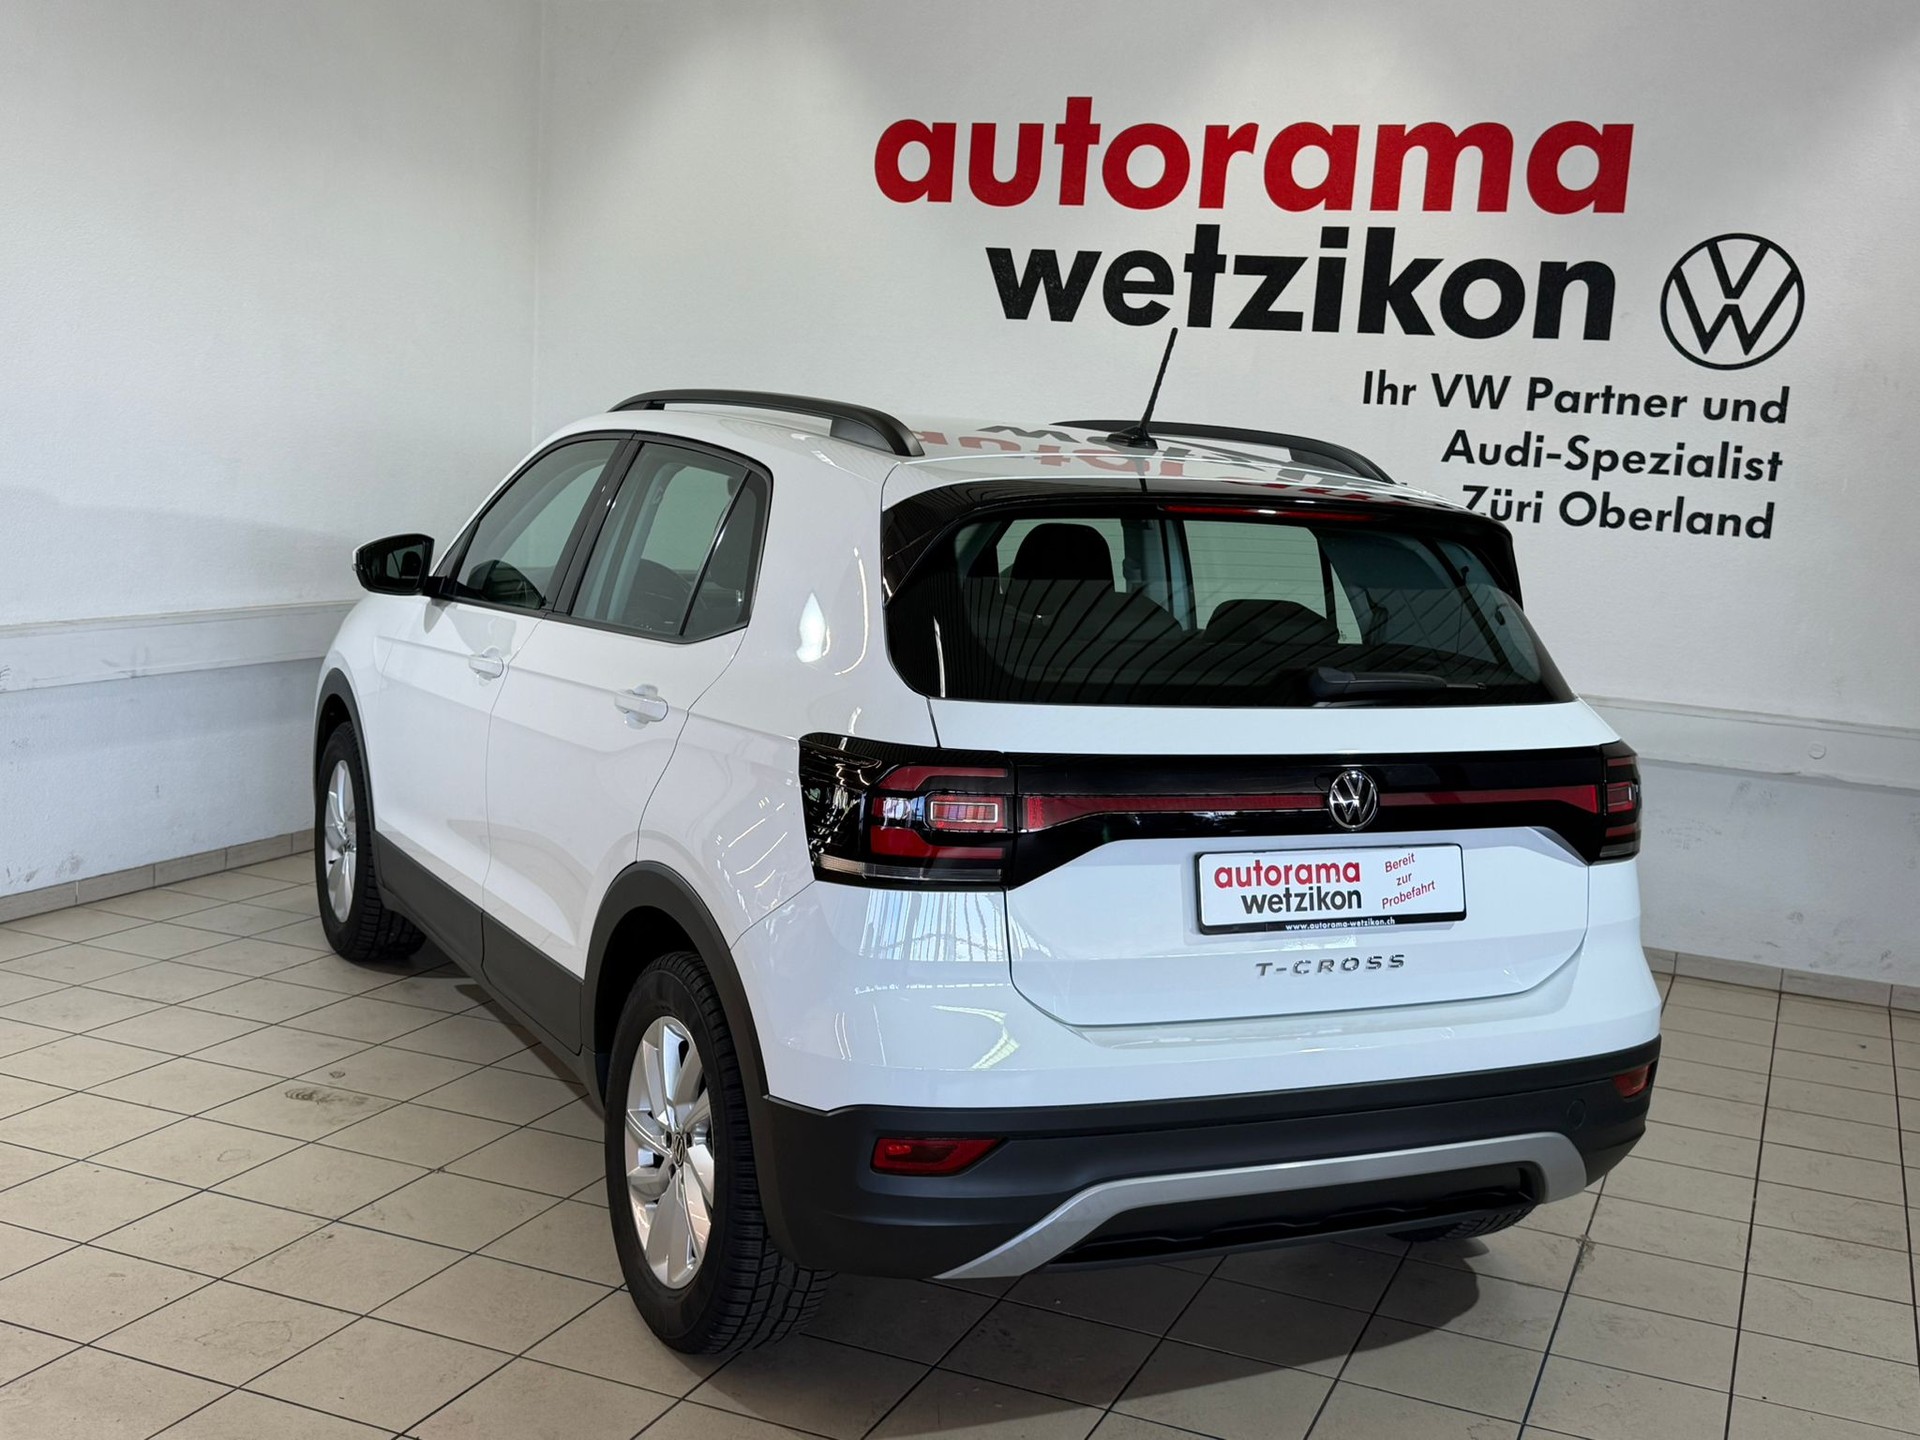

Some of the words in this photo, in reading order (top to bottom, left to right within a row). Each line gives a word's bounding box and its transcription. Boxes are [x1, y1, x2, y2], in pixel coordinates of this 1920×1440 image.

[874, 96, 1635, 215] autorama
[985, 223, 1617, 342] wetzikon
[1362, 369, 1417, 406] Ihr
[1430, 372, 1512, 410] VW
[1526, 376, 1688, 418] Partner
[1703, 385, 1791, 424] und
[1440, 429, 1784, 482] Audi-Spezialist
[1462, 484, 1544, 524] Züri
[1559, 490, 1776, 540] Oberland
[1213, 859, 1361, 889] autorama
[1384, 853, 1416, 873] Bereit
[1396, 871, 1413, 887] zur
[1241, 886, 1363, 914] wetzikon
[1381, 880, 1436, 910] Probefahrt
[1285, 916, 1396, 931] www.autorama-wetzikon.ch
[1255, 953, 1405, 977] T-CROSS
